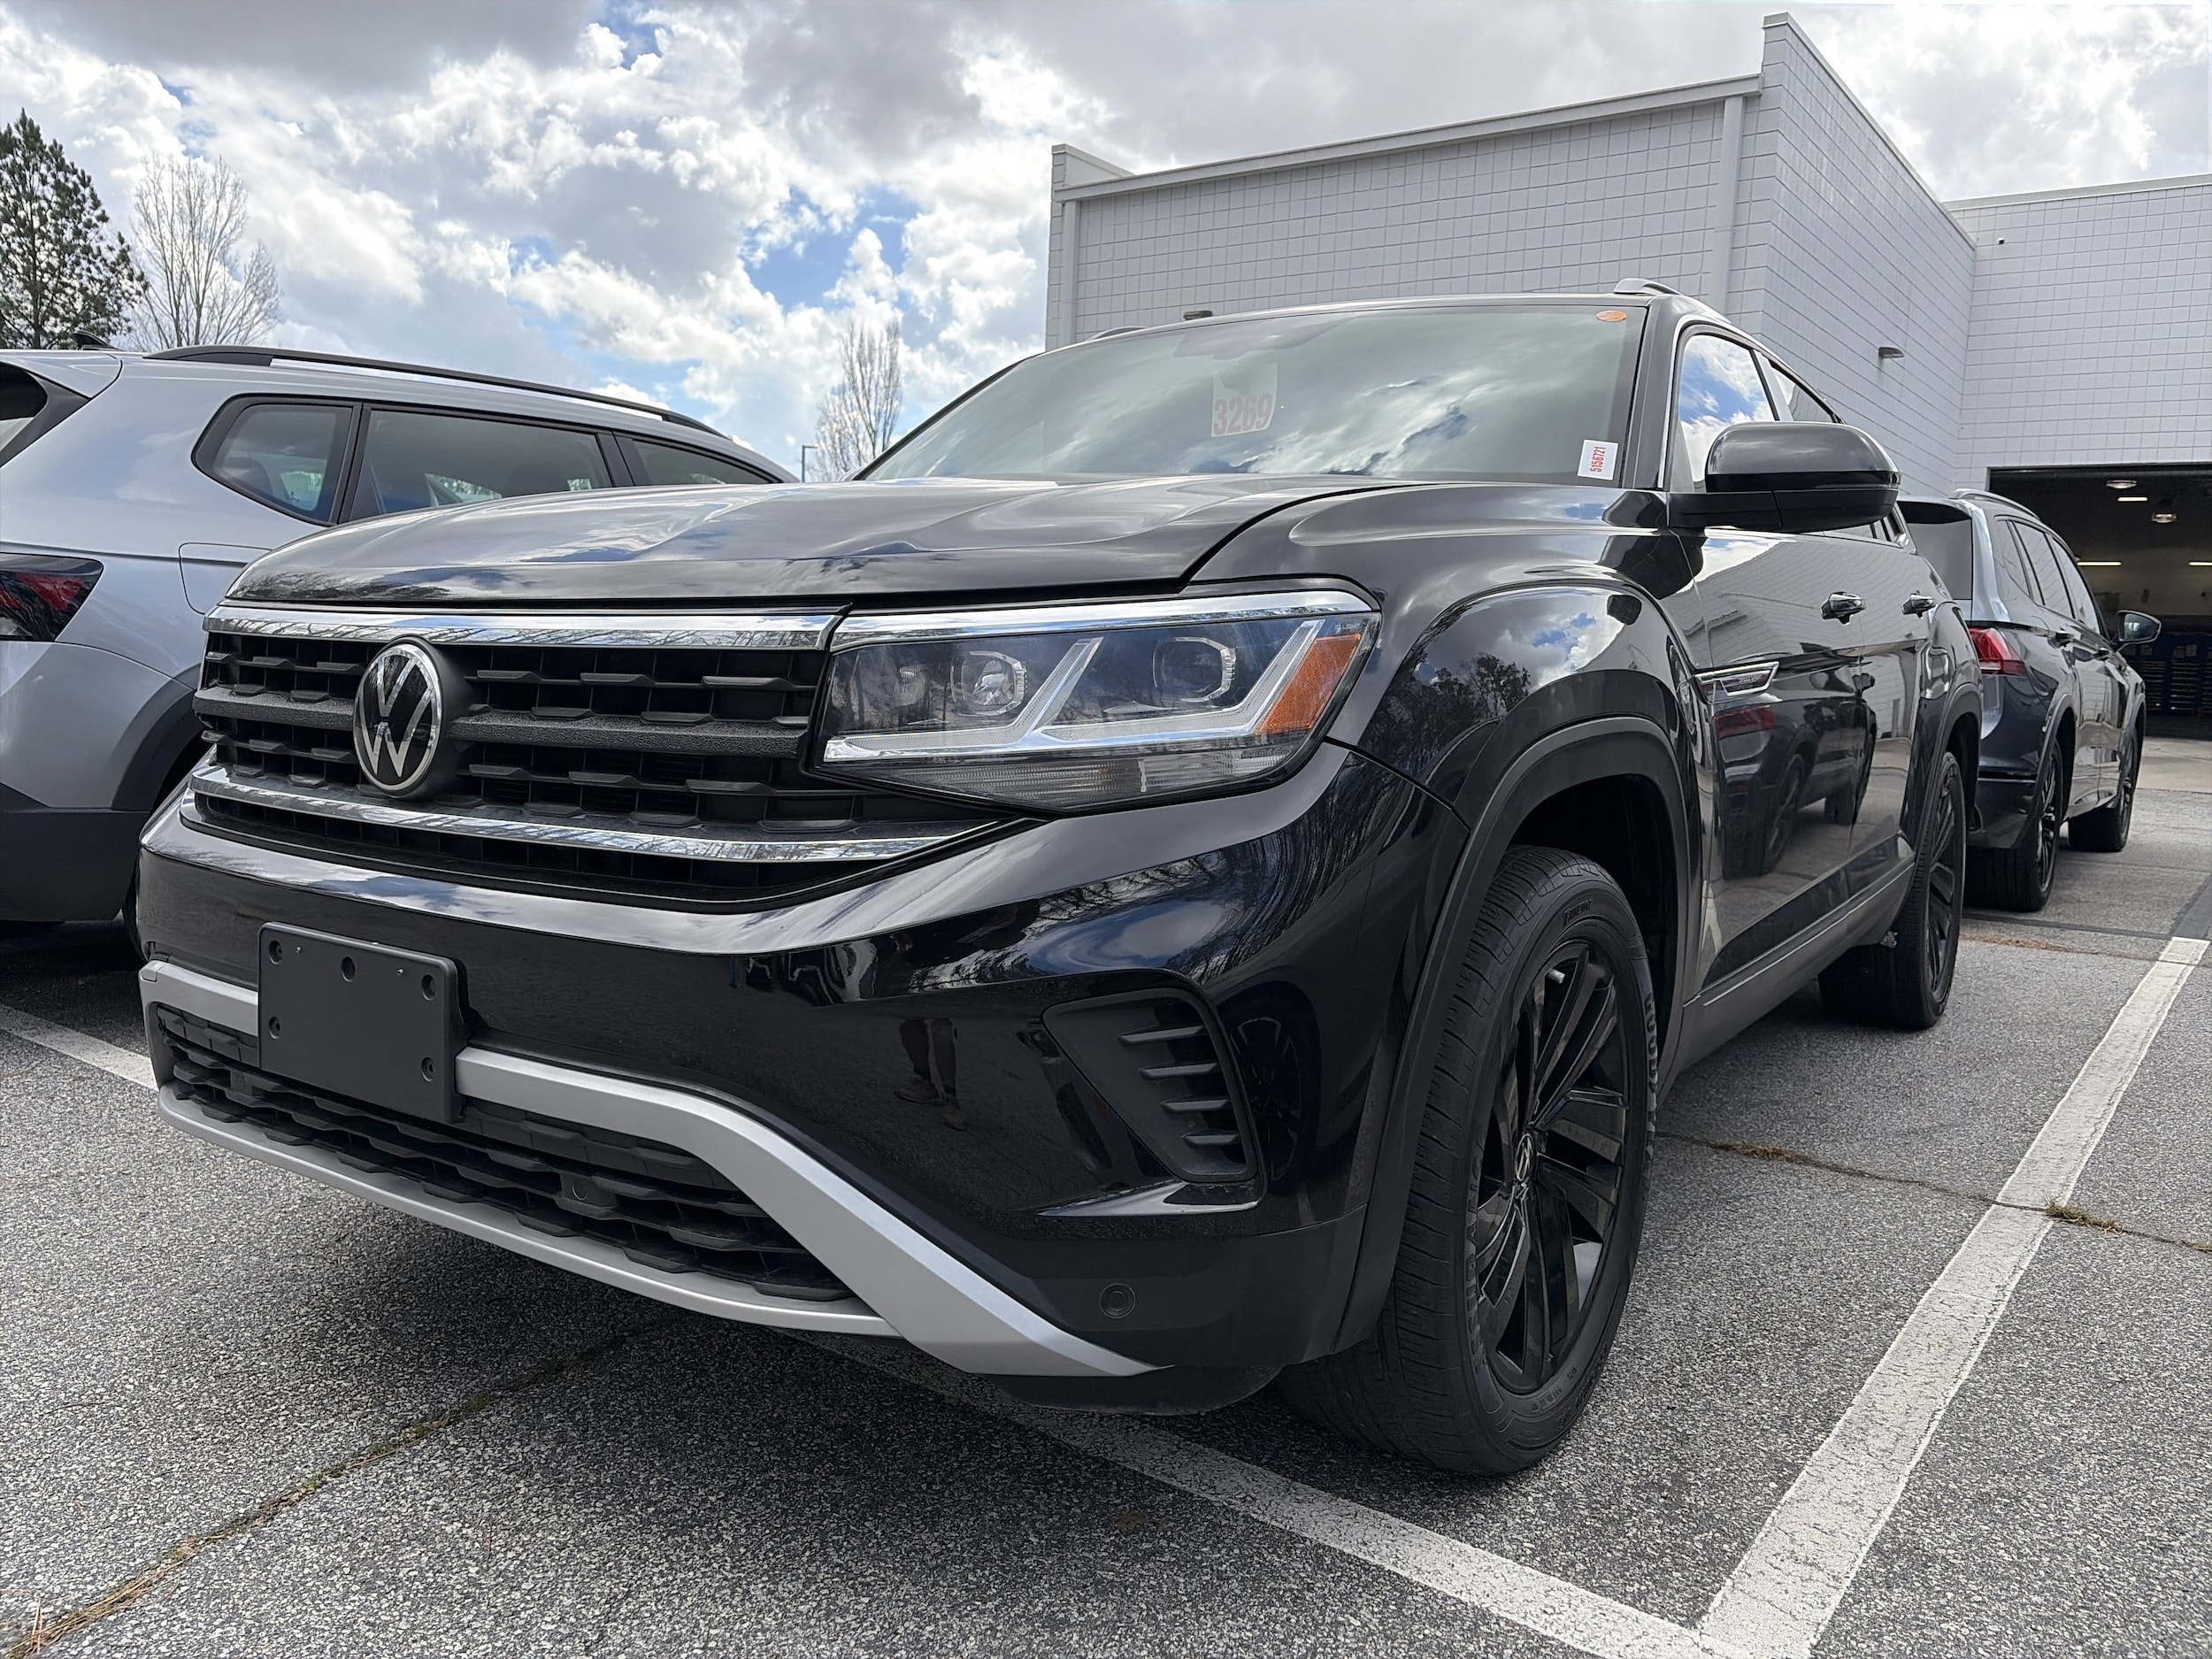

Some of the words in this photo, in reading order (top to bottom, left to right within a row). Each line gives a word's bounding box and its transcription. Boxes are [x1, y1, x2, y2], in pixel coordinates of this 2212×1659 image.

[1213, 392, 1273, 435] 3269
[1590, 446, 1607, 472] 5156721
[357, 653, 434, 779] VW
